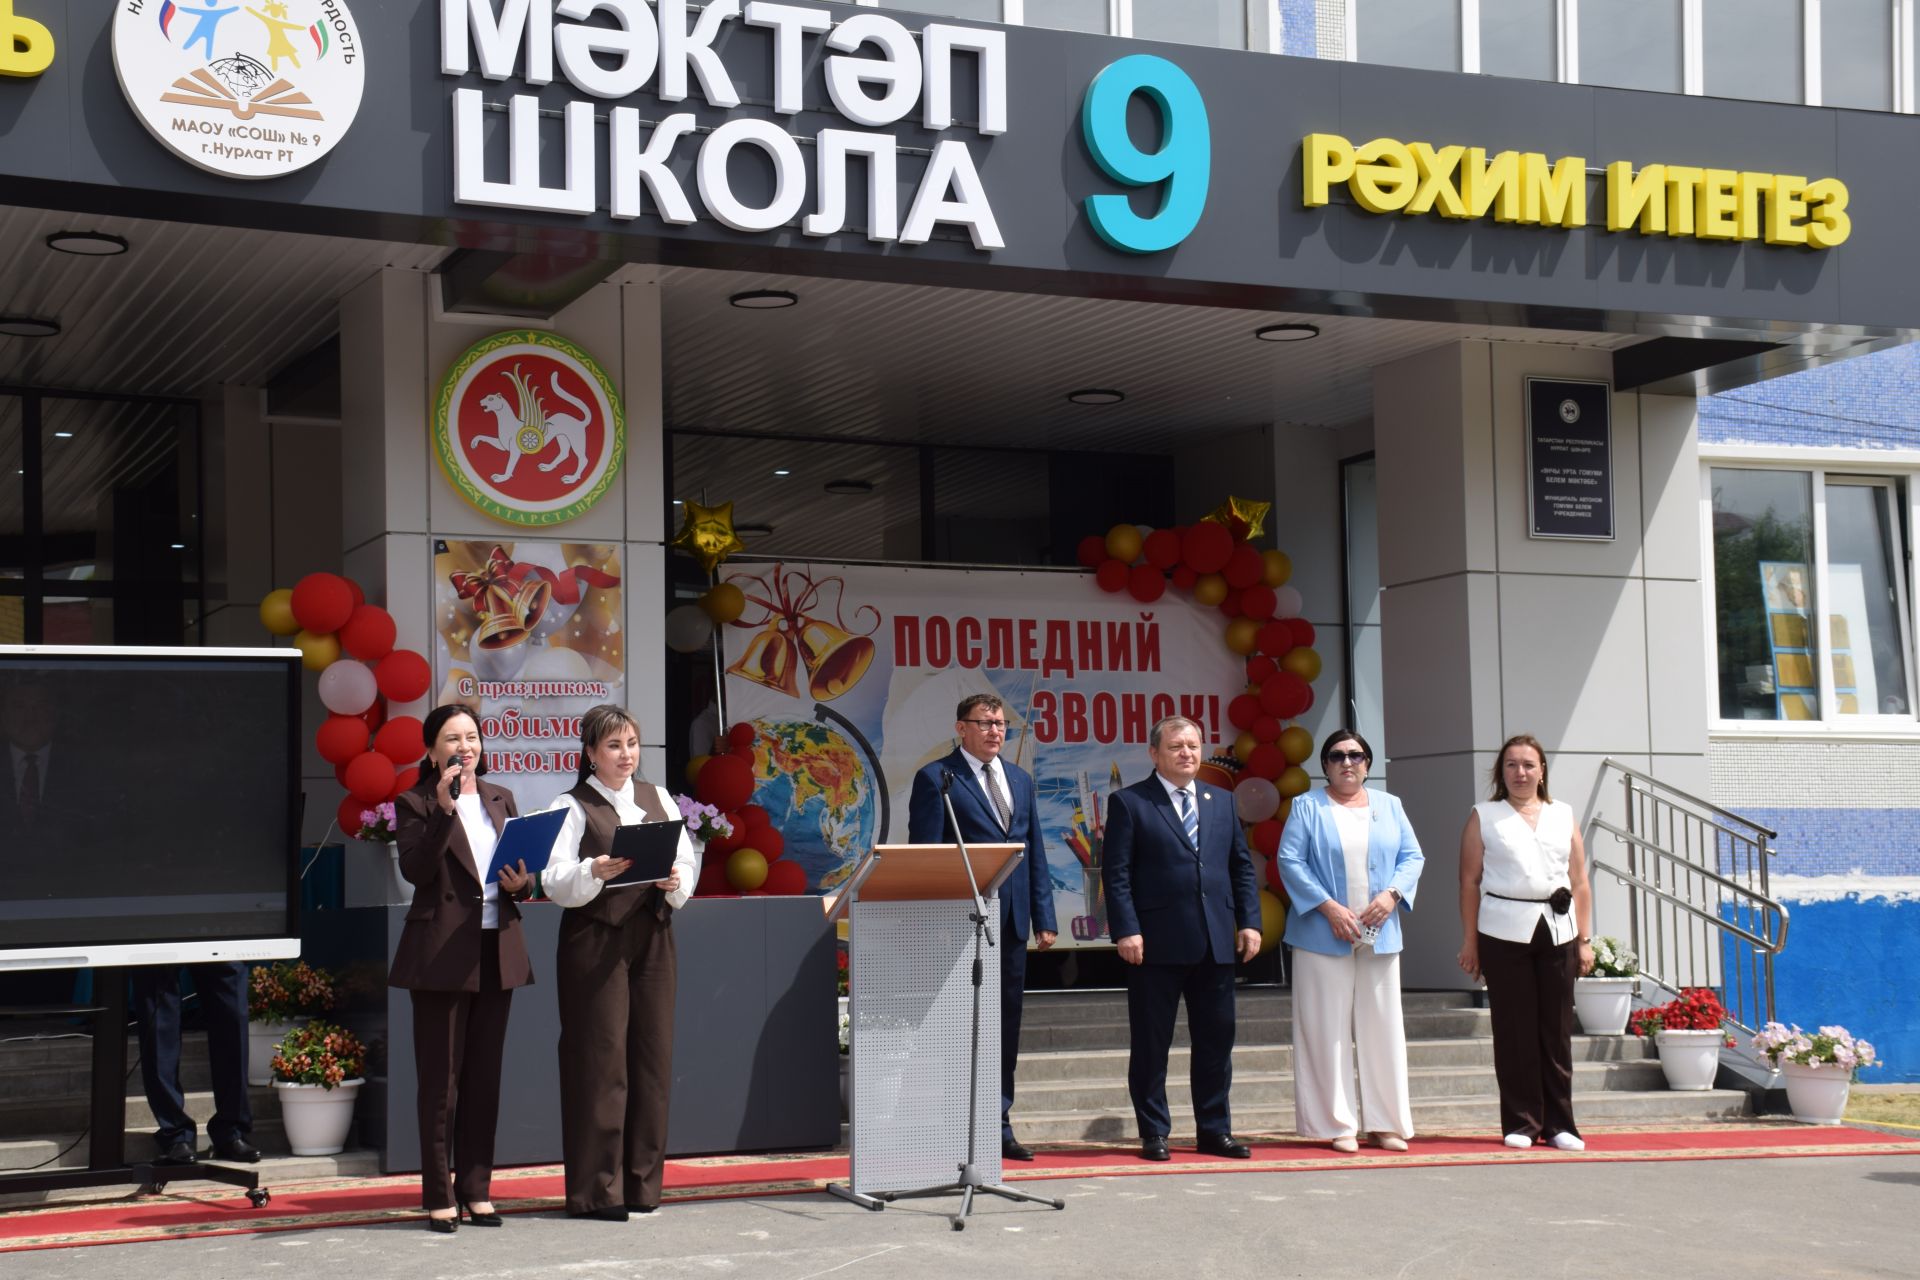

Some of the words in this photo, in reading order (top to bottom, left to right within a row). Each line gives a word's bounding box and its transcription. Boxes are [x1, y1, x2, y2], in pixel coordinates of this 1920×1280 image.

[320, 0, 355, 64] РДОСТЬ
[441, 0, 1007, 135] МӘКТӘП
[171, 118, 223, 136] МАОУ
[228, 125, 286, 143] «СОШ»
[312, 135, 321, 146] 9
[201, 142, 273, 160] г.Нурлат
[277, 150, 294, 163] РТ
[1082, 54, 1211, 255] 9
[453, 88, 1005, 250] ШКОЛА
[1303, 133, 1586, 228] РӘХИМ
[1607, 160, 1852, 249] ИТЕГЕЗ
[482, 499, 587, 523] ТАТАРСТАН
[893, 611, 1162, 679] ПОСЛЕДНИЙ
[459, 678, 472, 697] С
[478, 681, 608, 700] праздником,
[1033, 690, 1220, 744] ЗВОНОК!
